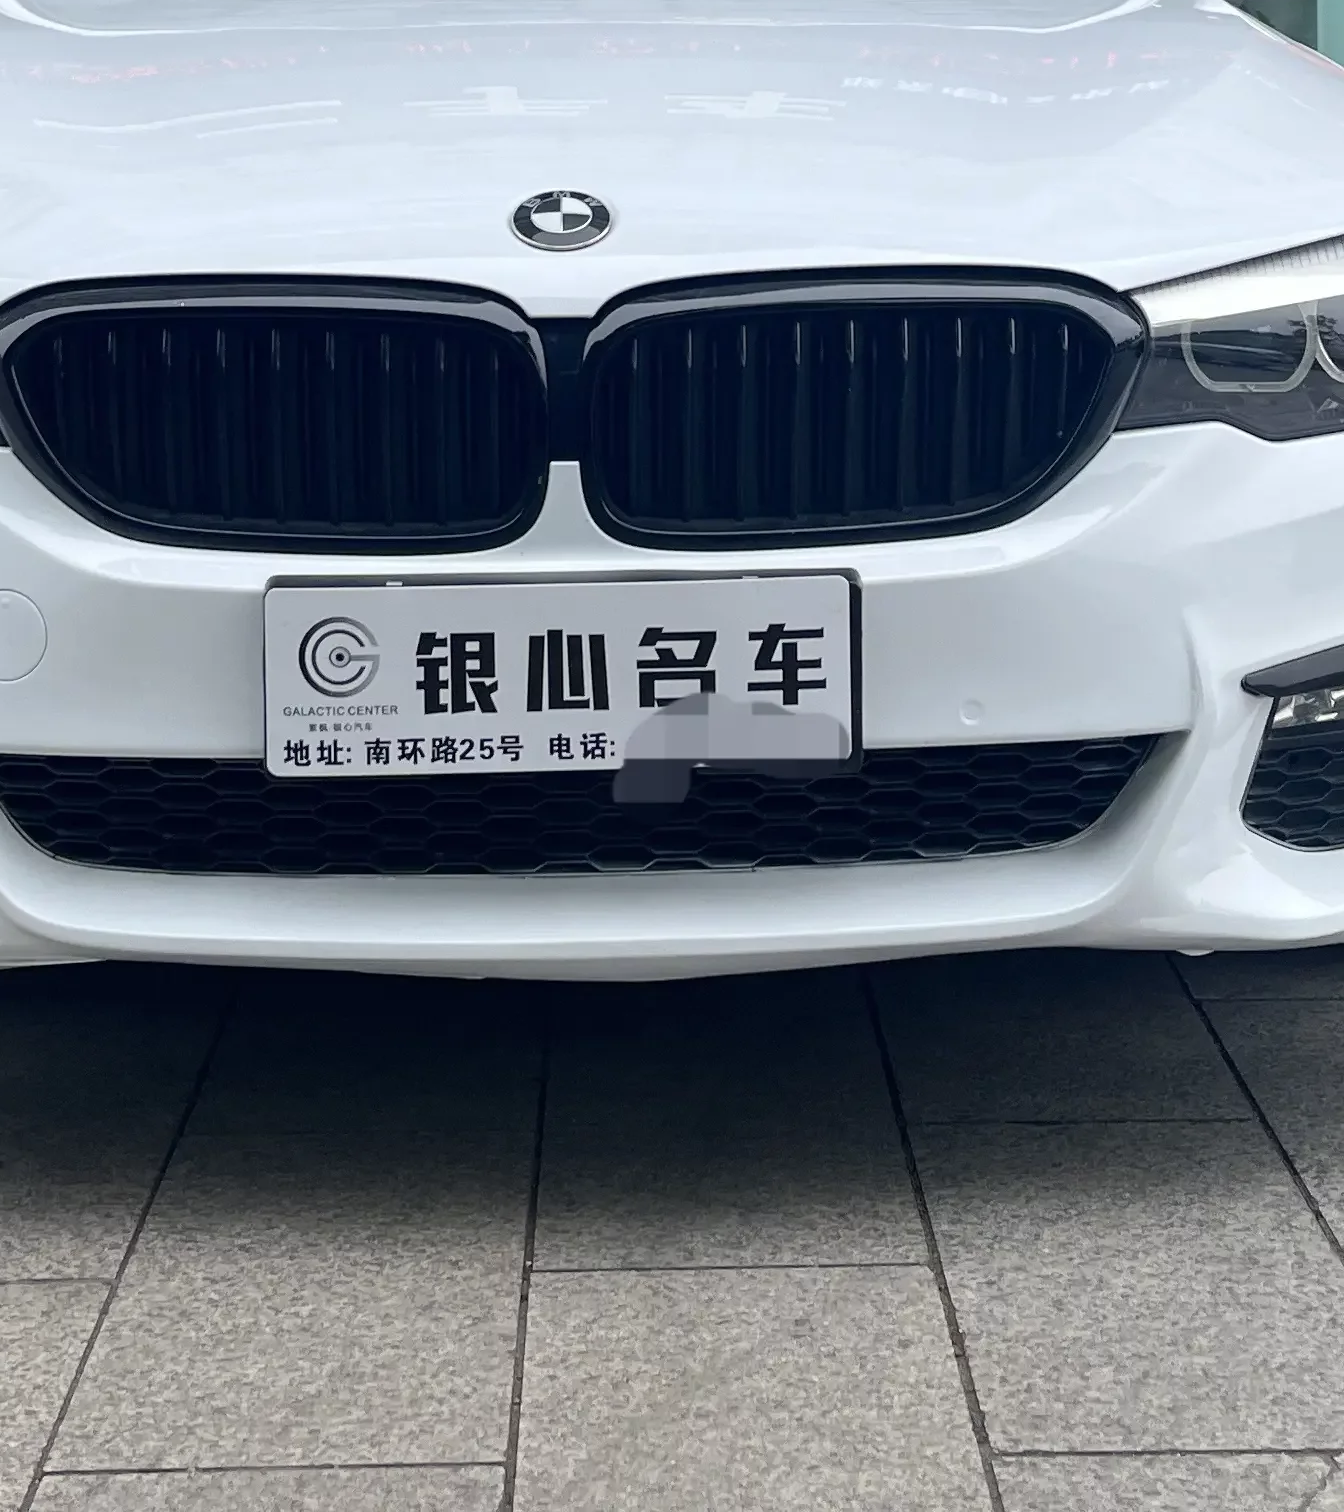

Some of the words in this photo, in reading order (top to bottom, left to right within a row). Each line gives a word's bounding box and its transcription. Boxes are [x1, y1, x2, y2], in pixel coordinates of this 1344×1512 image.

[415, 622, 827, 716] 银心名车
[282, 705, 345, 717] GALACTIC
[347, 704, 399, 716] CENTER
